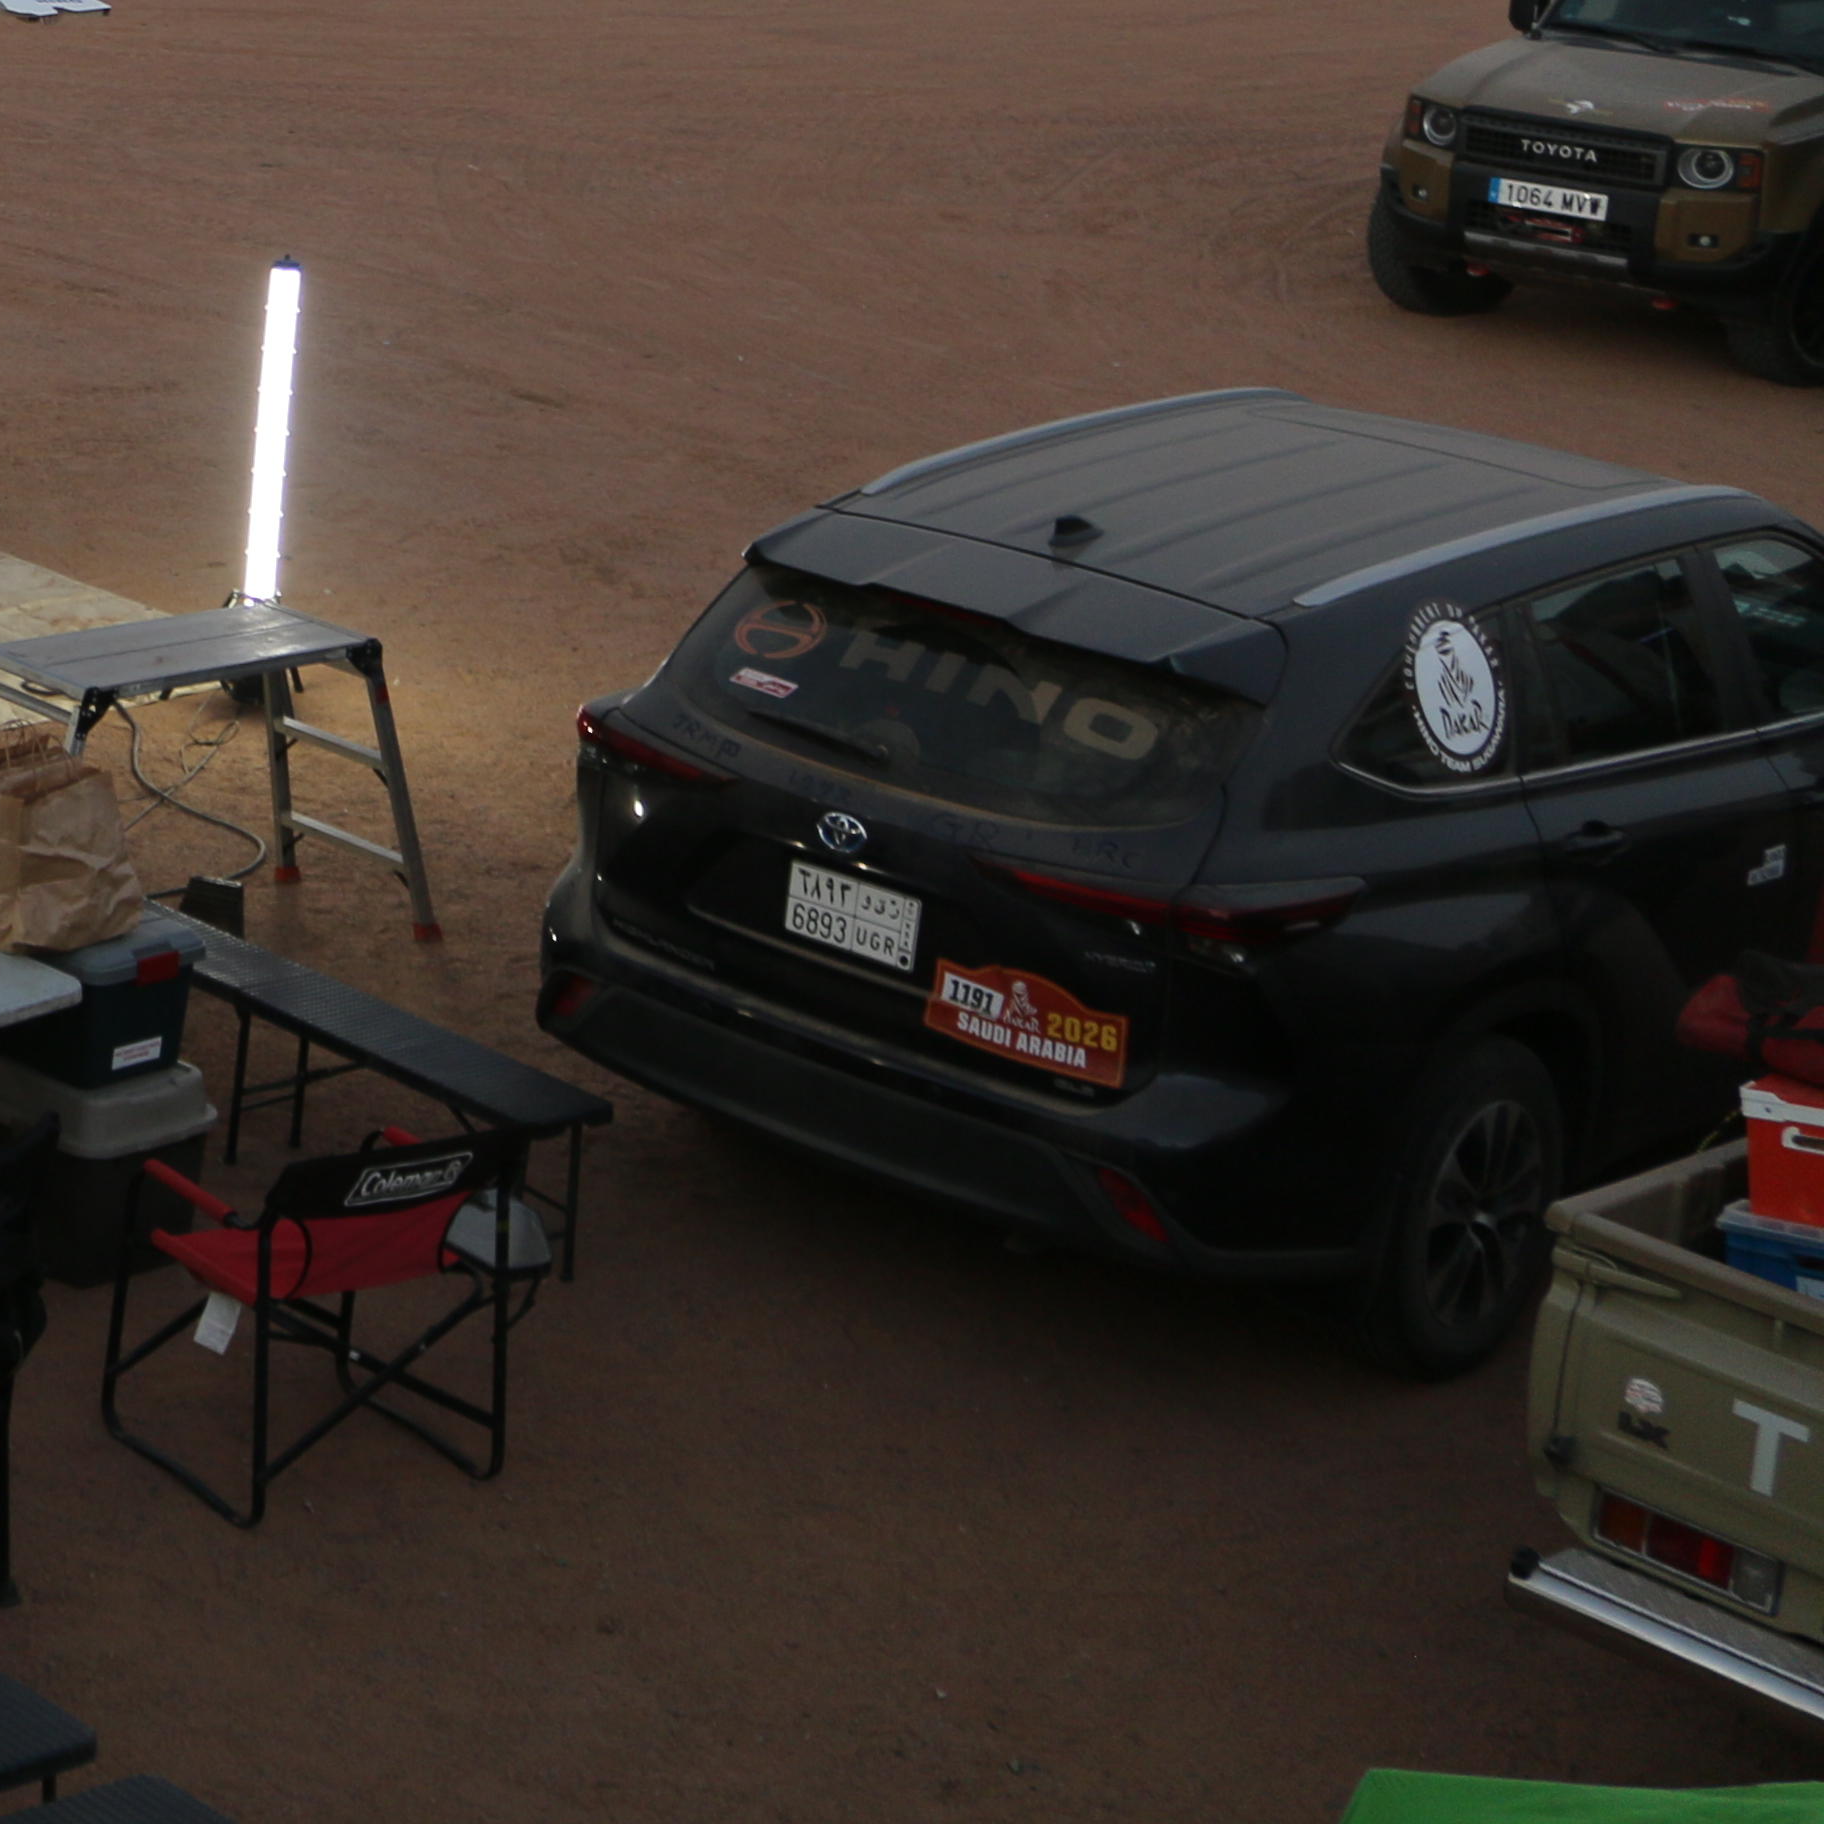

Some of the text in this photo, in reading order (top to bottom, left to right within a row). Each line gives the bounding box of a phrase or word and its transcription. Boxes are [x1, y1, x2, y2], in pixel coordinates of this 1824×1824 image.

[1520, 139, 1599, 163] TOYOTA
[1504, 182, 1555, 210] 1064
[839, 629, 1164, 762] HINO
[1440, 699, 1491, 740] DAKAR
[1441, 752, 1472, 773] TEAM
[792, 903, 848, 944] 6893
[856, 927, 895, 957] UGR
[949, 979, 995, 1015] 1191
[956, 1010, 1089, 1069] SAUDI ARABIA
[1045, 1011, 1120, 1052] 2026
[360, 1166, 445, 1198] Coleman
[1732, 1398, 1810, 1497] T
